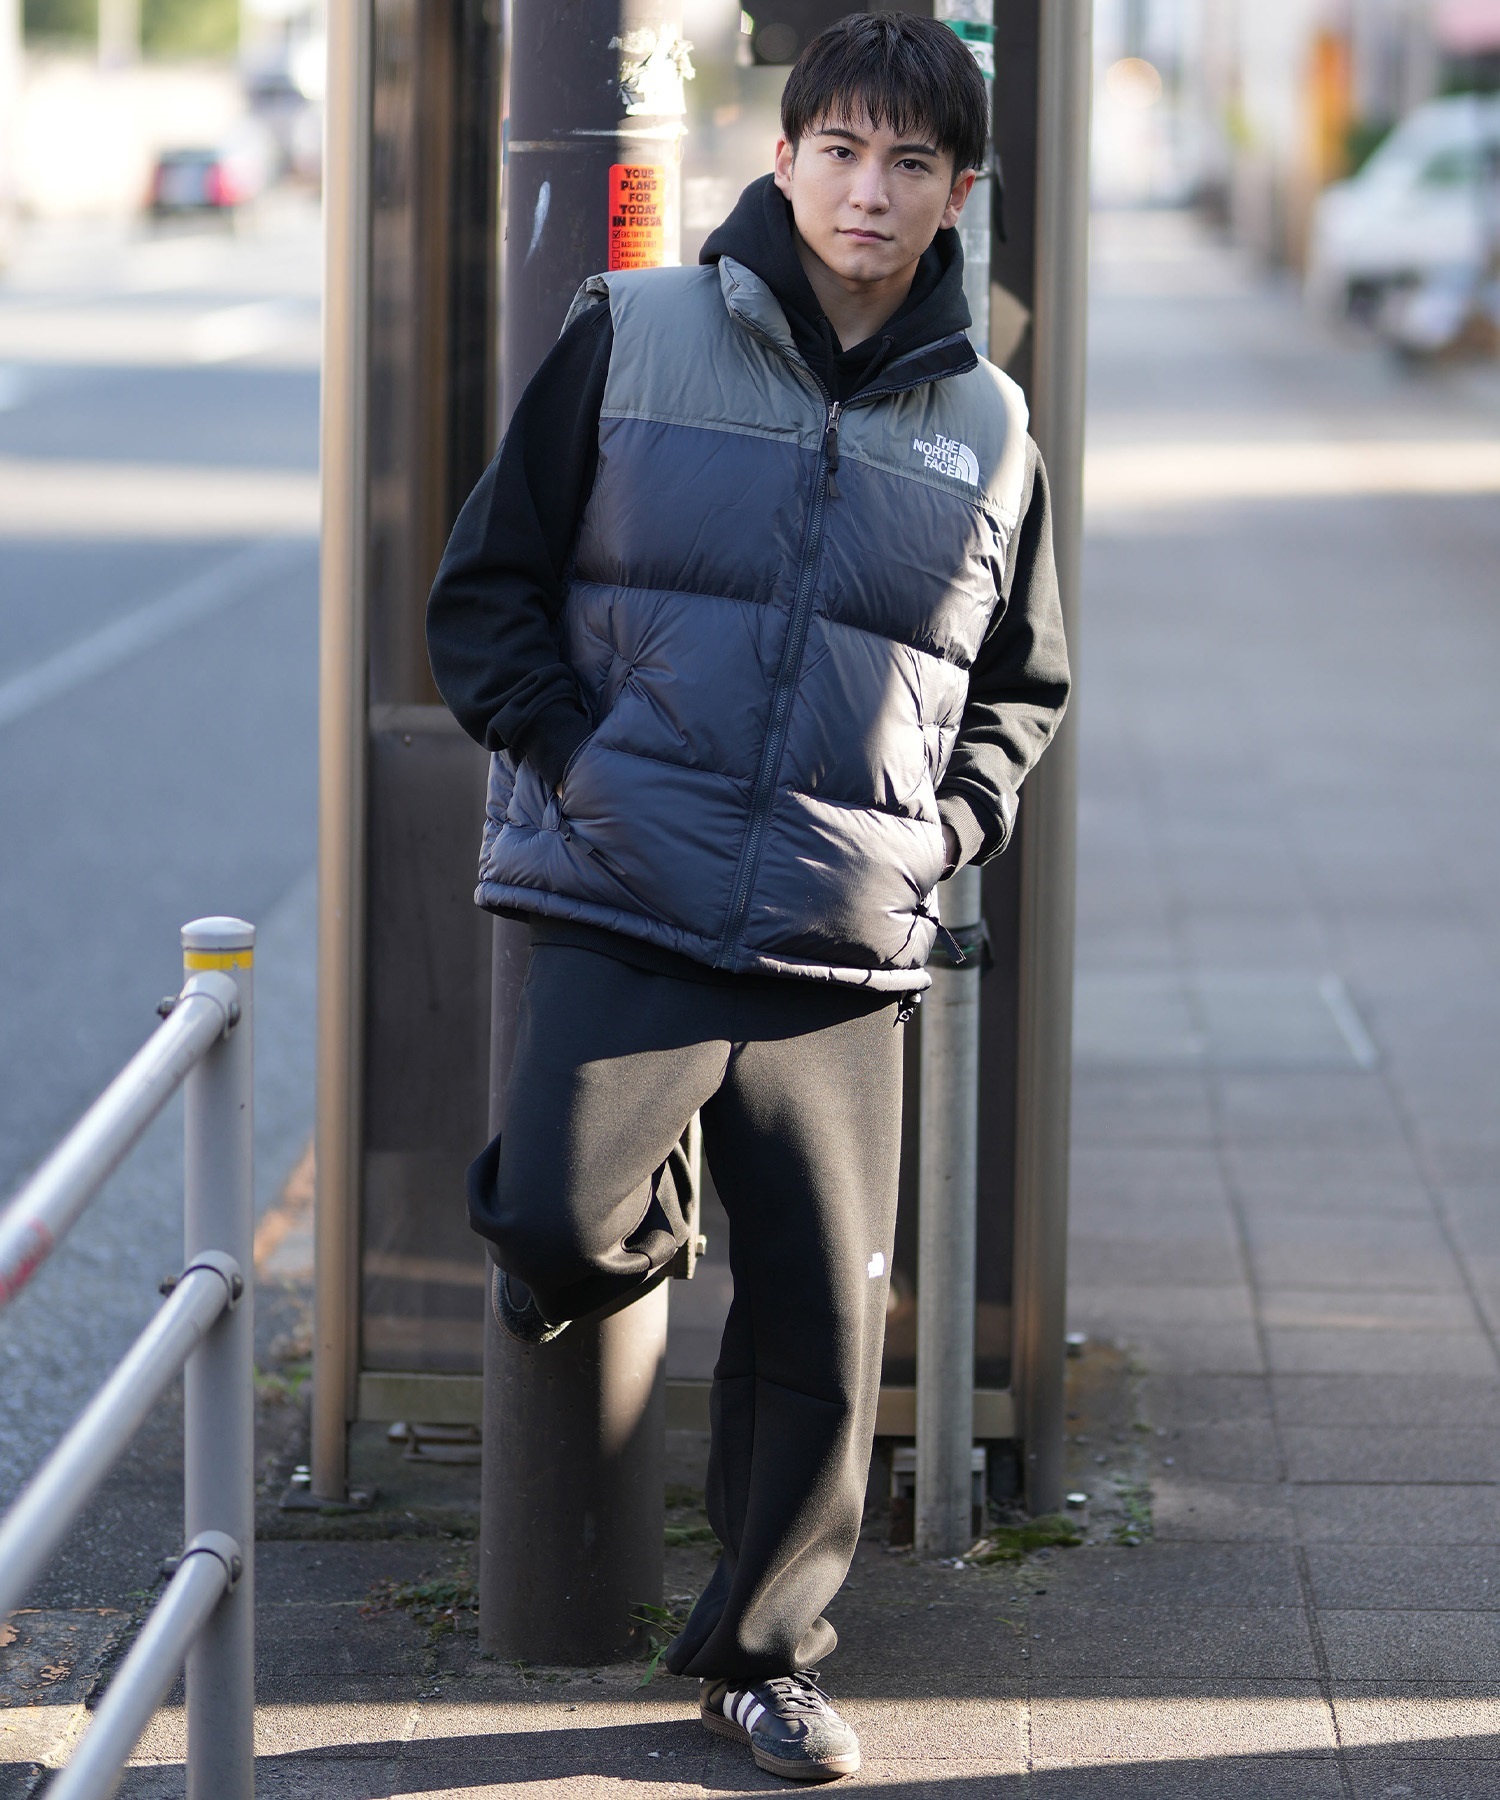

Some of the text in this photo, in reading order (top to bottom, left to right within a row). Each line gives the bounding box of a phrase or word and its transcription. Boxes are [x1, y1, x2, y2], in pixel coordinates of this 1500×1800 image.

[624, 168, 654, 179] YOUR
[621, 180, 657, 191] PLANS
[629, 193, 651, 203] FOR
[620, 205, 657, 215] TODAY
[612, 216, 662, 227] IN FUSSA
[935, 434, 959, 453] THE
[913, 438, 957, 466] NORTH
[923, 455, 956, 478] FACE
